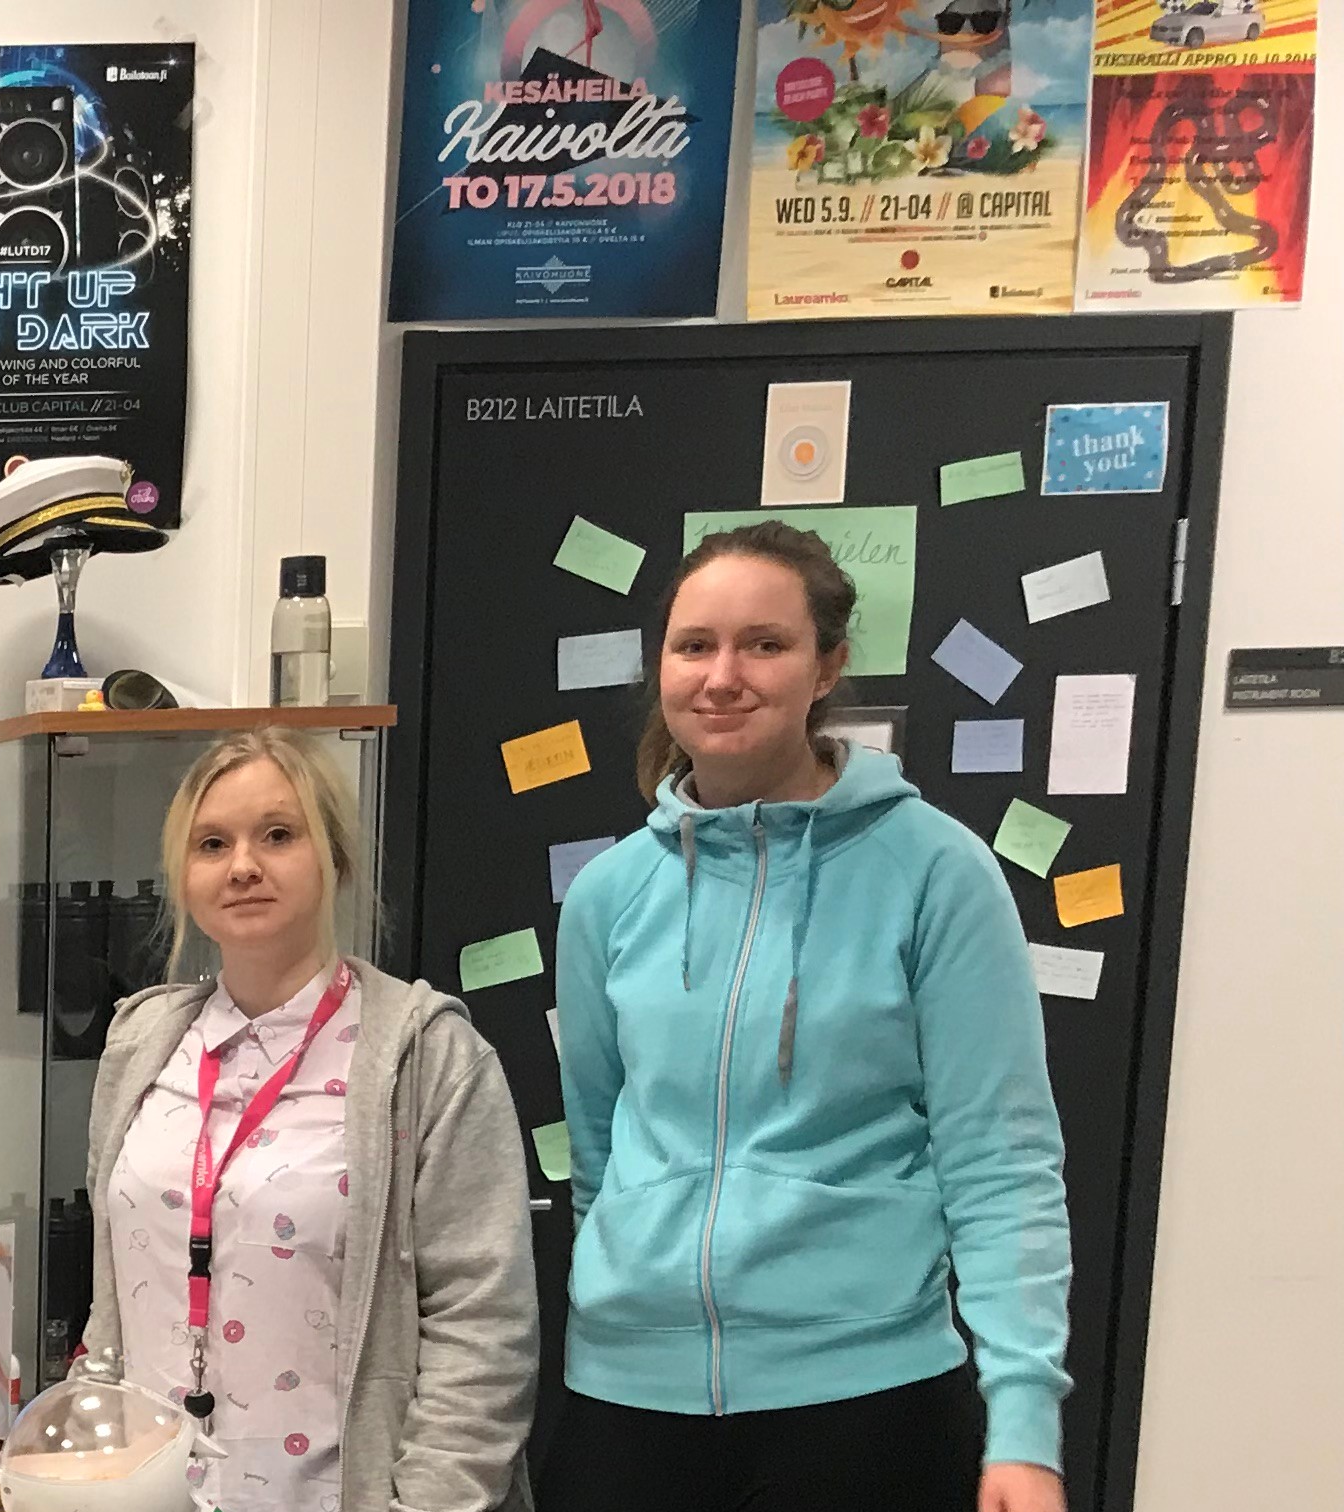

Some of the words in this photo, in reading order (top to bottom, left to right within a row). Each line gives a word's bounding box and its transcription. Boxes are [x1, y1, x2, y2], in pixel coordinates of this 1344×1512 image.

[437, 94, 692, 165] Kaivolta
[442, 175, 499, 209] TO
[504, 172, 676, 208] 17.5.2018
[776, 197, 815, 225] WED
[821, 197, 855, 223] 5.9.
[880, 194, 932, 220] 21-04
[979, 190, 1053, 218] CAPITAL
[0, 245, 51, 257] #LUTD17
[68, 270, 136, 308] UP
[17, 312, 150, 351] DARK
[3, 374, 20, 386] OF
[24, 373, 50, 385] THE
[53, 372, 89, 384] YEAR
[38, 358, 68, 370] AND
[71, 356, 141, 370] COLORFUL
[31, 400, 88, 412] CAPITAL
[467, 398, 517, 421] B212
[525, 395, 644, 419] LAITETILA
[1072, 424, 1146, 459] thank
[1082, 447, 1137, 481] you!
